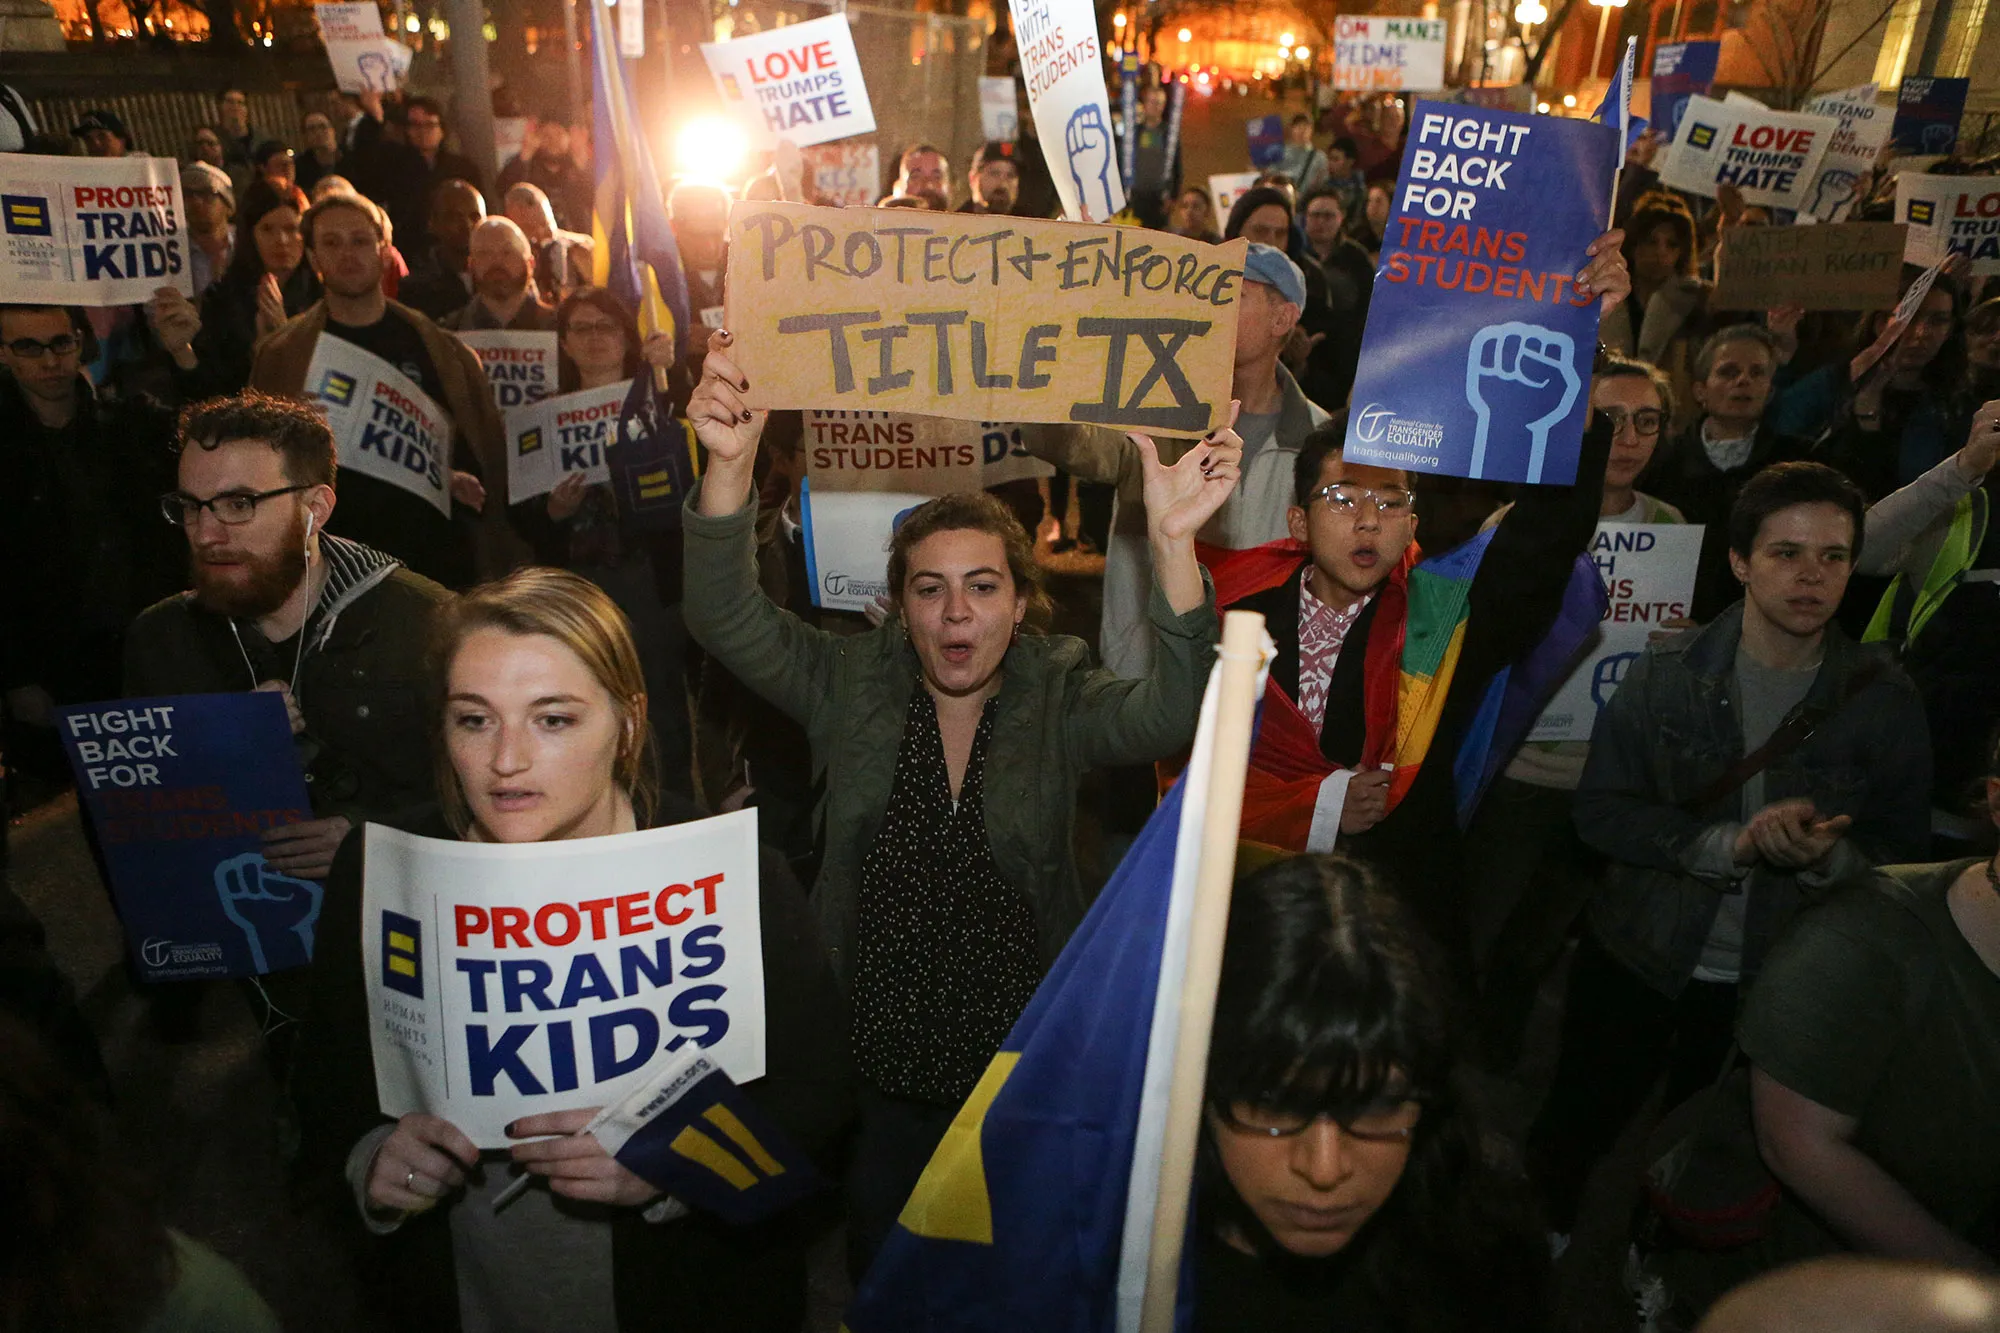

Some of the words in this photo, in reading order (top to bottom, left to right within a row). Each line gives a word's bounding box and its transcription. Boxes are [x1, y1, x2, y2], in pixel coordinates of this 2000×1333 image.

[1019, 4, 1050, 46] WITH
[746, 41, 837, 84] LOVE
[1024, 26, 1064, 73] TRANS
[1030, 36, 1096, 102] STUDENTS
[755, 70, 843, 104] TRUMPS
[762, 91, 852, 132] HATE
[1827, 101, 1875, 120] STAND
[1419, 113, 1530, 155] FIGHT
[1732, 123, 1816, 153] LOVE
[1411, 149, 1512, 190] BACK
[1727, 147, 1805, 169] TRUMPS
[1716, 162, 1797, 193] HATE
[74, 186, 173, 209] PROTECT
[1402, 183, 1477, 220] FOR
[1955, 192, 2000, 218] LO
[77, 209, 178, 239] TRANS
[1398, 217, 1528, 262] TRANS
[1952, 220, 1998, 235] TRU
[83, 239, 182, 280] KIDS
[744, 211, 1014, 285] PROTECT
[1057, 230, 1246, 306] ENFORCE
[778, 310, 1062, 396] TITLE
[1070, 317, 1213, 431] IX
[811, 423, 914, 445] TRANS
[1388, 424, 1443, 438] TRANSGENDER
[1390, 418, 1416, 427] National
[1387, 432, 1442, 448] EQUALITY
[360, 422, 443, 490] KIDS
[813, 445, 975, 470] STUDENTS
[1353, 445, 1439, 467] transequality.org
[1594, 531, 1656, 551] AND
[1602, 602, 1685, 623] DENTS
[67, 706, 174, 737] FIGHT
[76, 734, 178, 763] BACK
[87, 763, 162, 789] FOR
[454, 873, 725, 949] PROTECT
[456, 924, 726, 1013] TRANS
[465, 984, 730, 1097] KIDS
